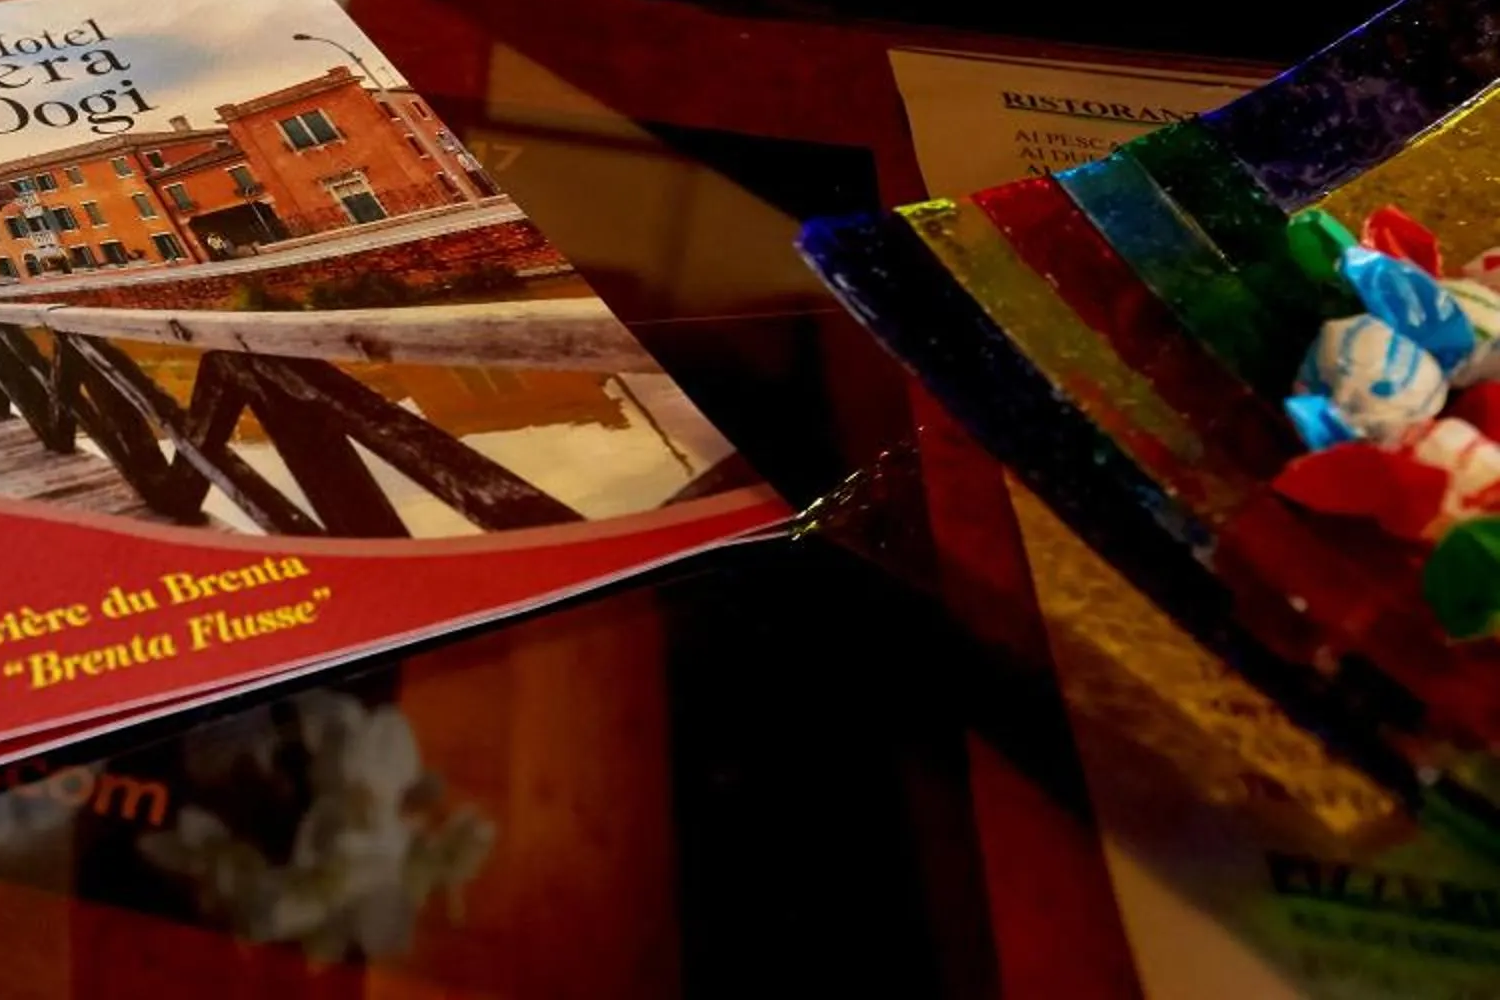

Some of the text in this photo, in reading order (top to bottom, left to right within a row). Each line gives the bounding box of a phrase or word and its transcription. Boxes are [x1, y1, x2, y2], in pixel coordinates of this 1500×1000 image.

[101, 584, 159, 618] du
[160, 556, 310, 605] Brenta
[3, 631, 177, 690] “Brenta
[187, 587, 331, 651] Flusse”
